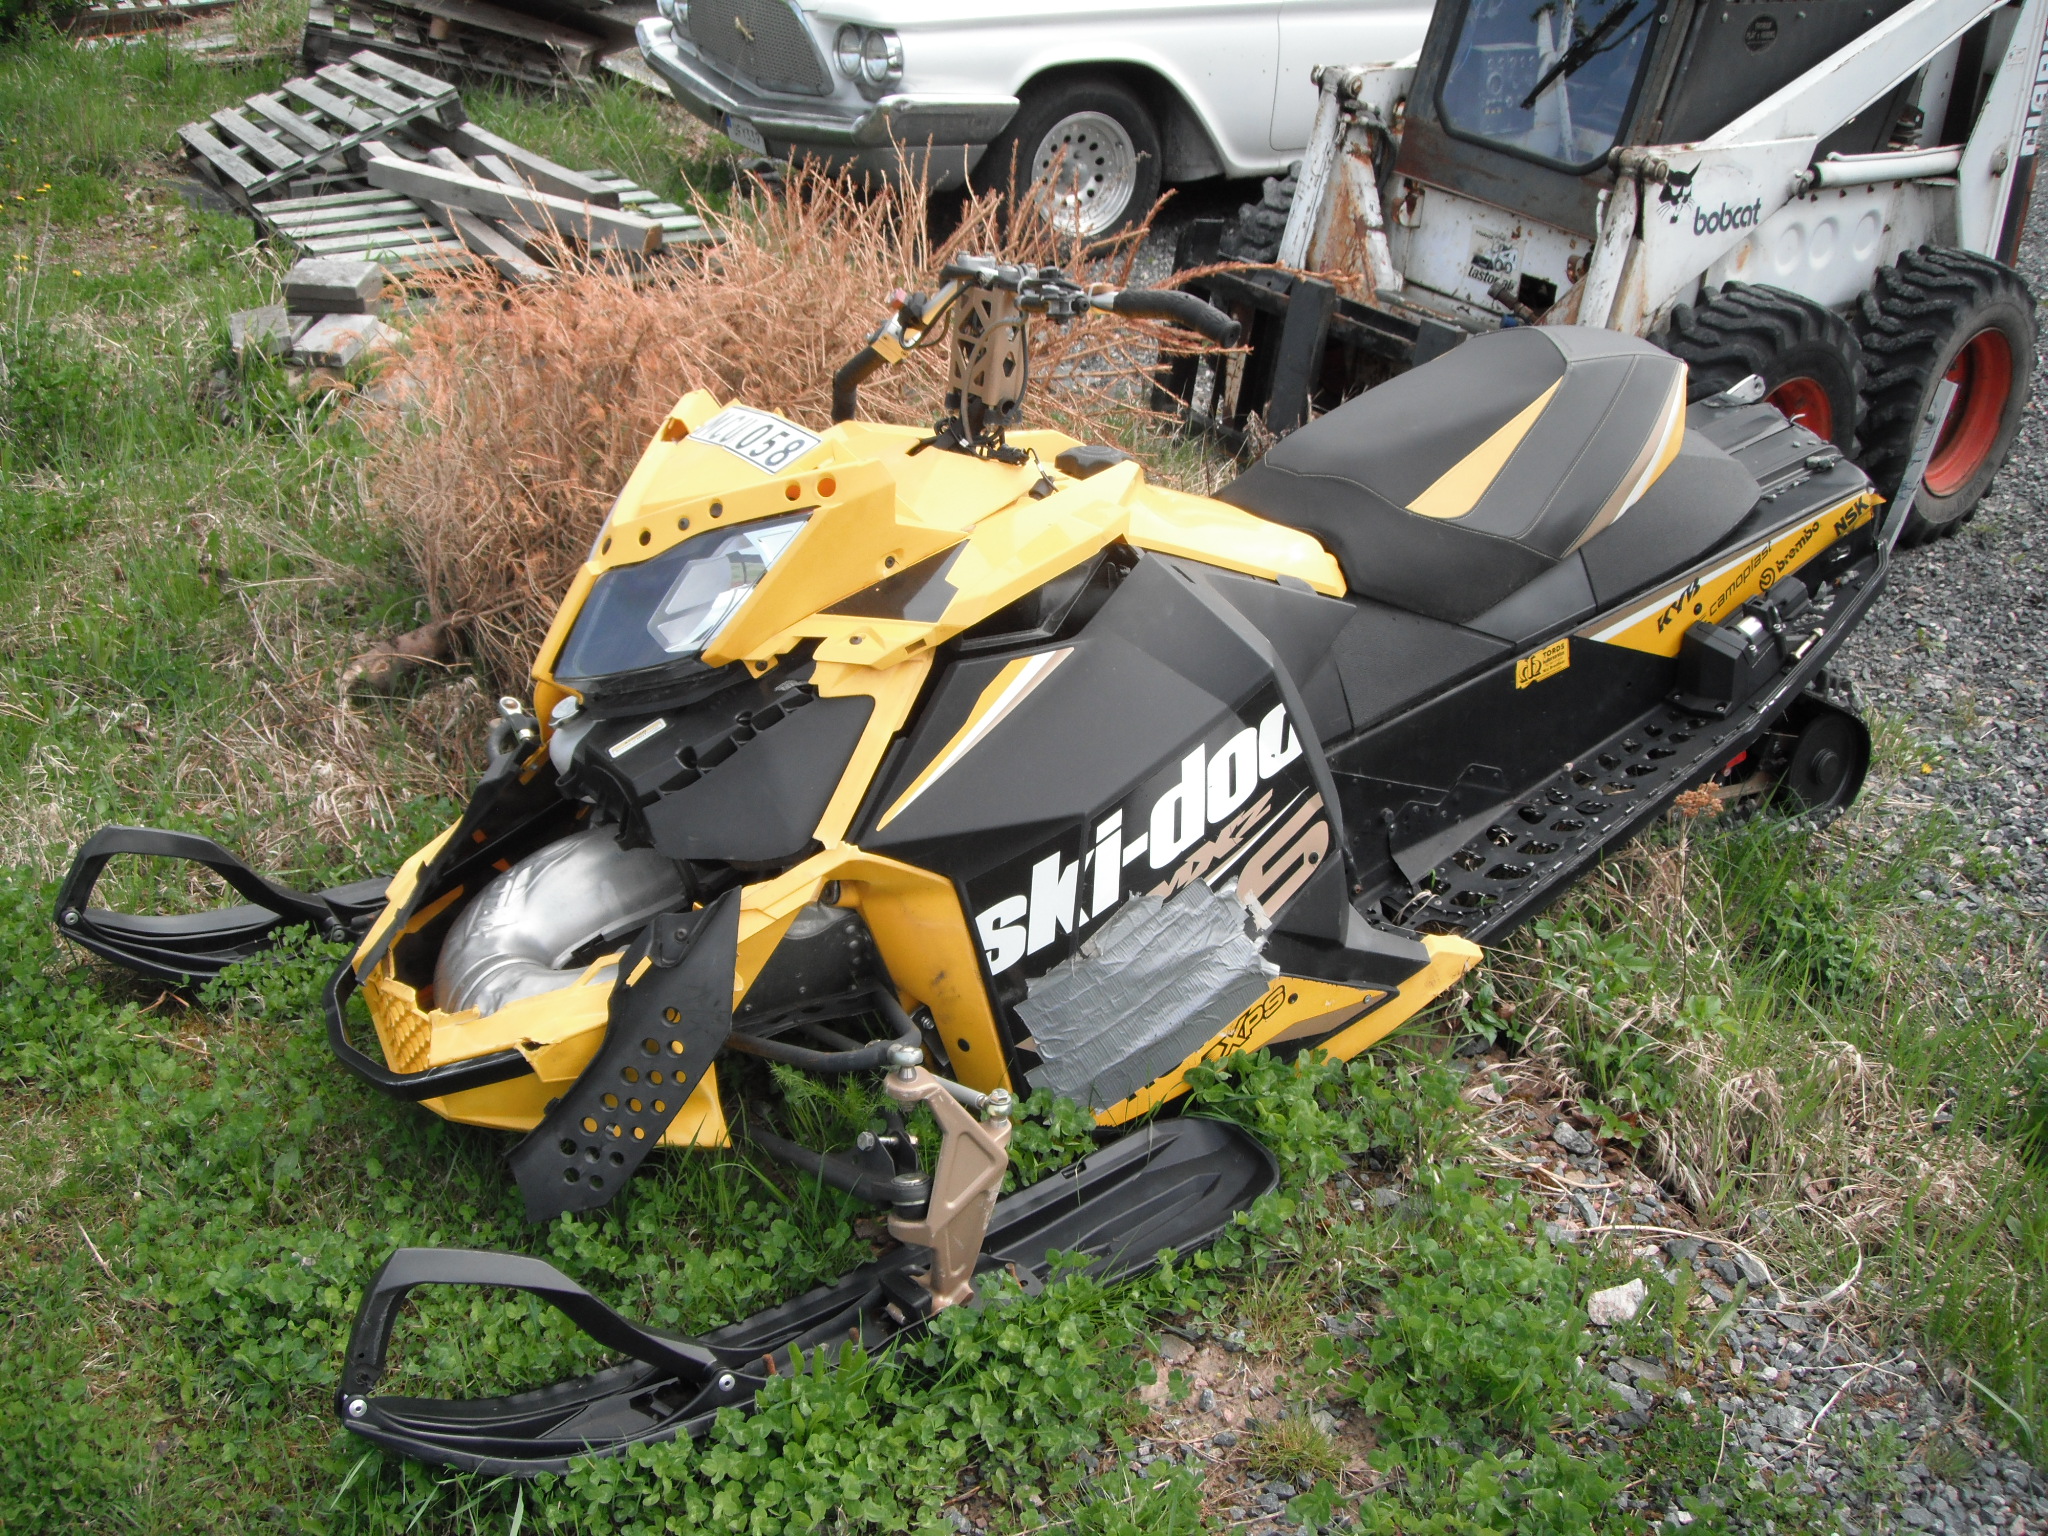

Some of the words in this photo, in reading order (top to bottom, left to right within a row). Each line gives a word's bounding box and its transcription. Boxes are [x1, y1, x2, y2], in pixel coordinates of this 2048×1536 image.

[1693, 198, 1761, 236] bobcat
[1775, 521, 1820, 573] brembo
[1833, 495, 1869, 537] NSK
[1709, 540, 1772, 617] camoplast
[975, 703, 1303, 976] ski-doo
[1201, 984, 1286, 1060] XPS
